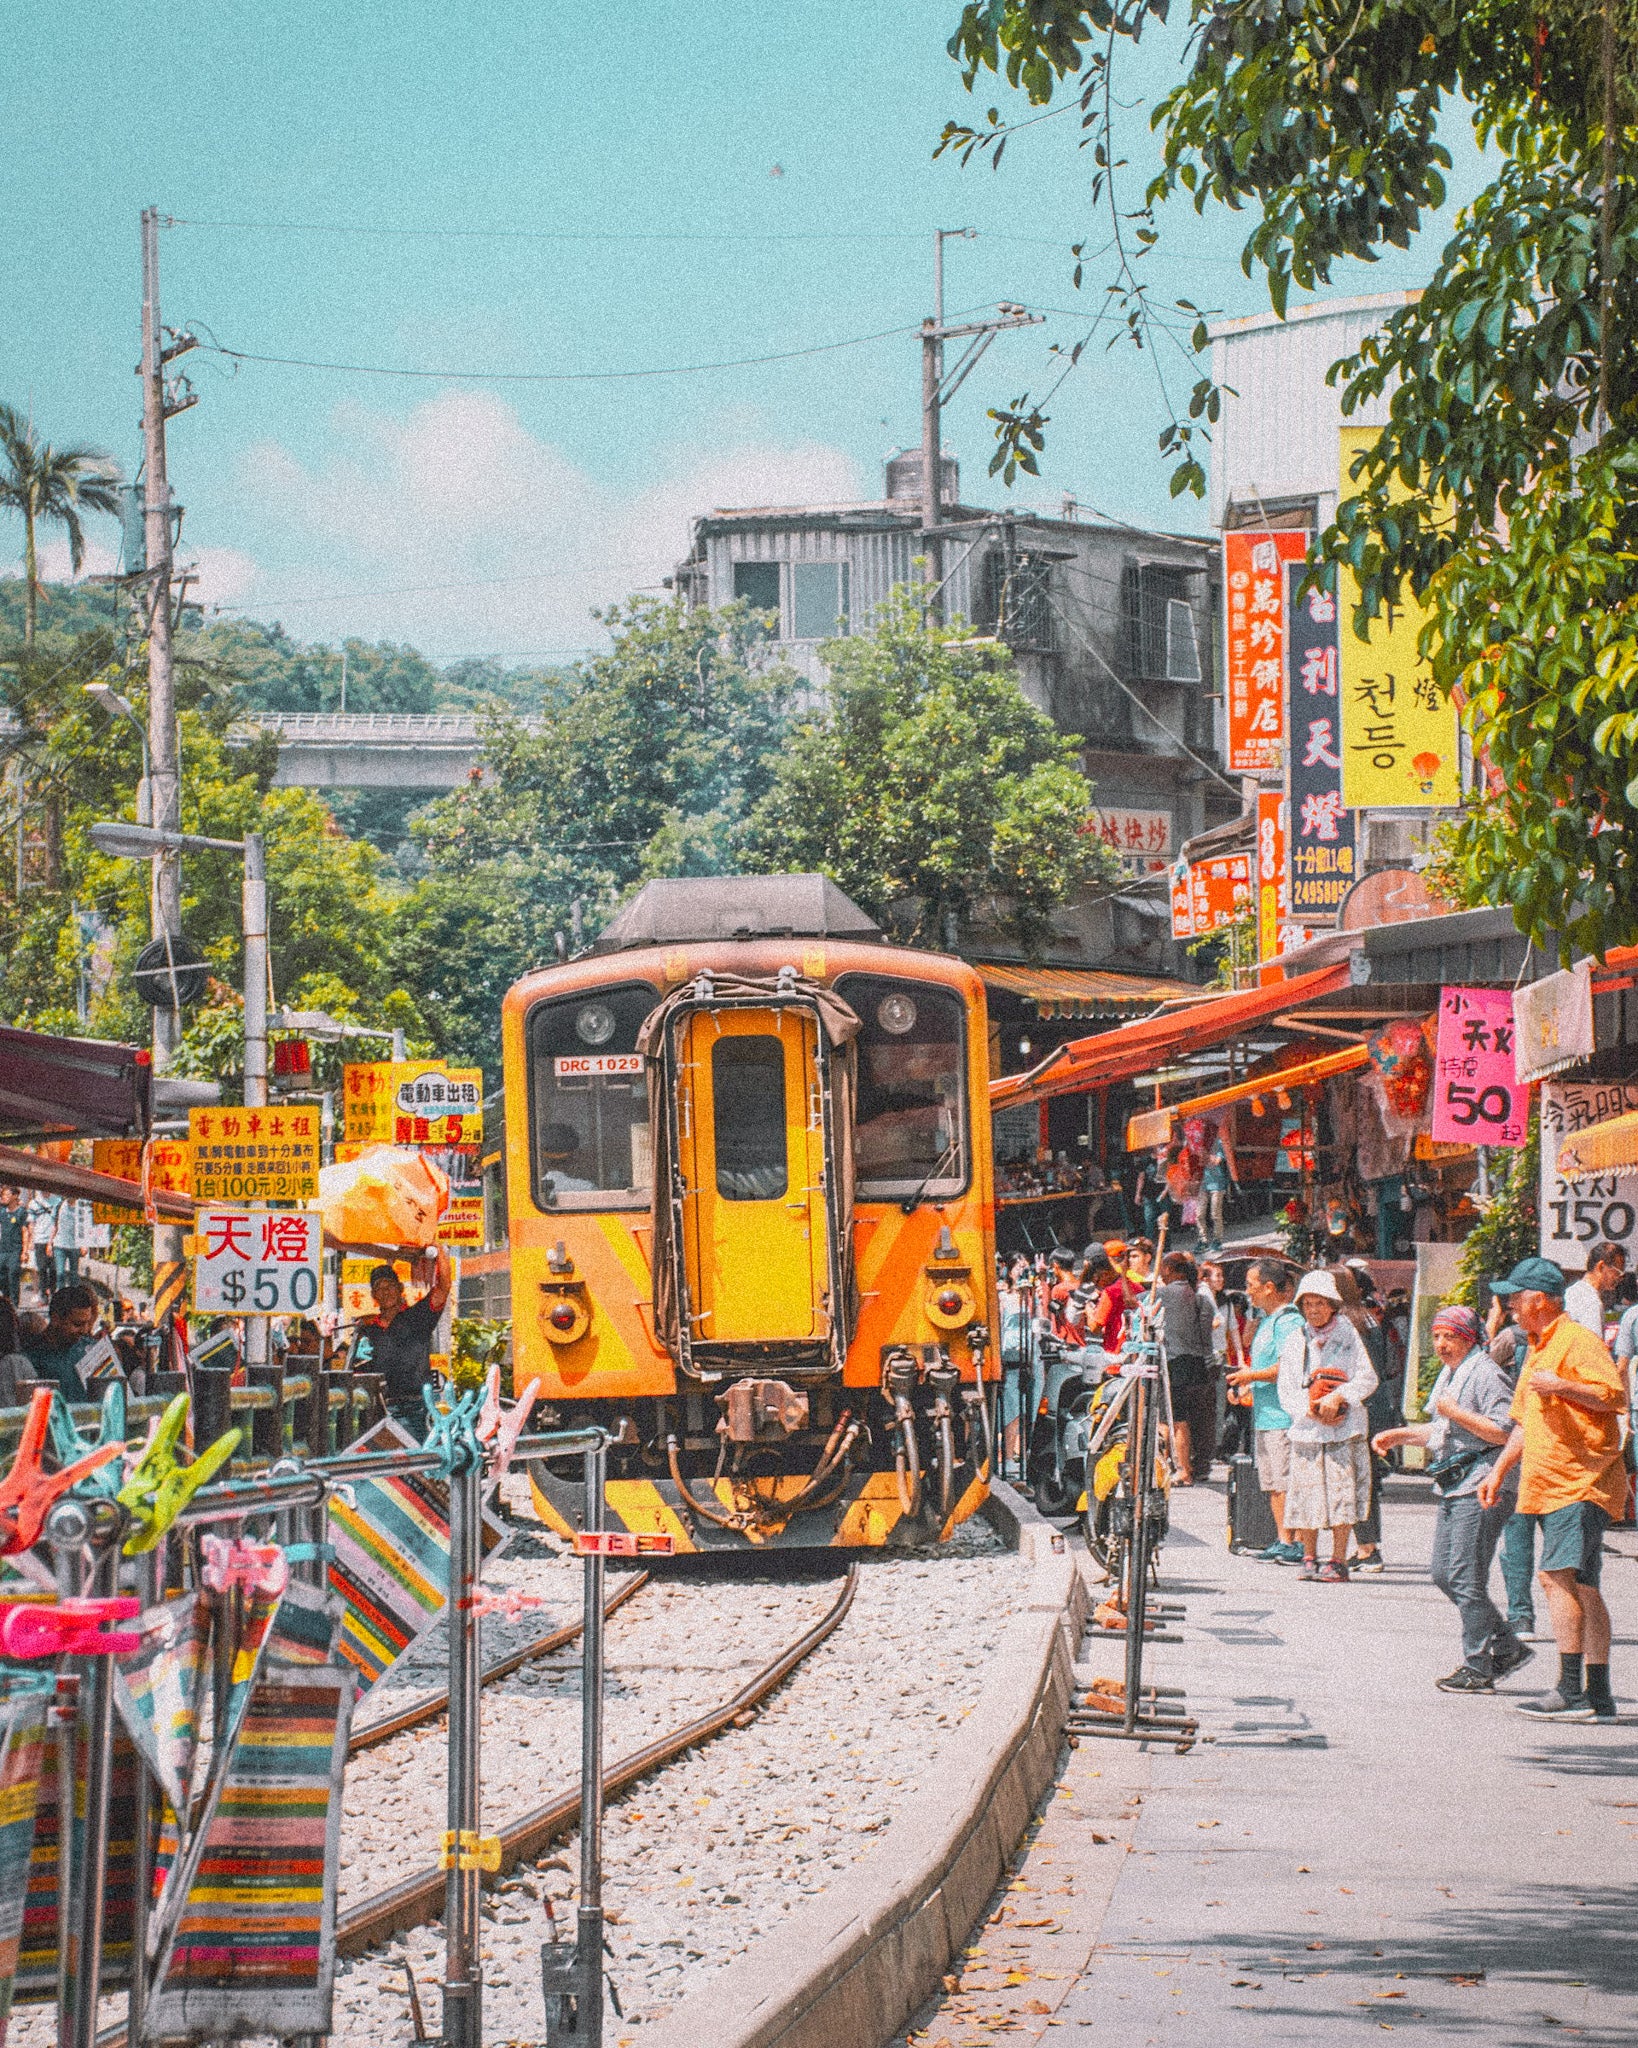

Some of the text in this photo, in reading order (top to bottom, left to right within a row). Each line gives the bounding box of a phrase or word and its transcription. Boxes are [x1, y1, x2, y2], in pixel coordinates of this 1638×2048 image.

[1446, 994, 1469, 1014] 小
[560, 1057, 640, 1072] DRC 1029
[400, 1083, 475, 1103] 電動車出租
[1447, 1081, 1512, 1126] 50
[195, 1113, 312, 1138] 電動車出租
[1502, 1124, 1522, 1141] 起
[1548, 1200, 1636, 1242] 150
[205, 1215, 309, 1263] 天燈
[221, 1267, 318, 1311] $50
